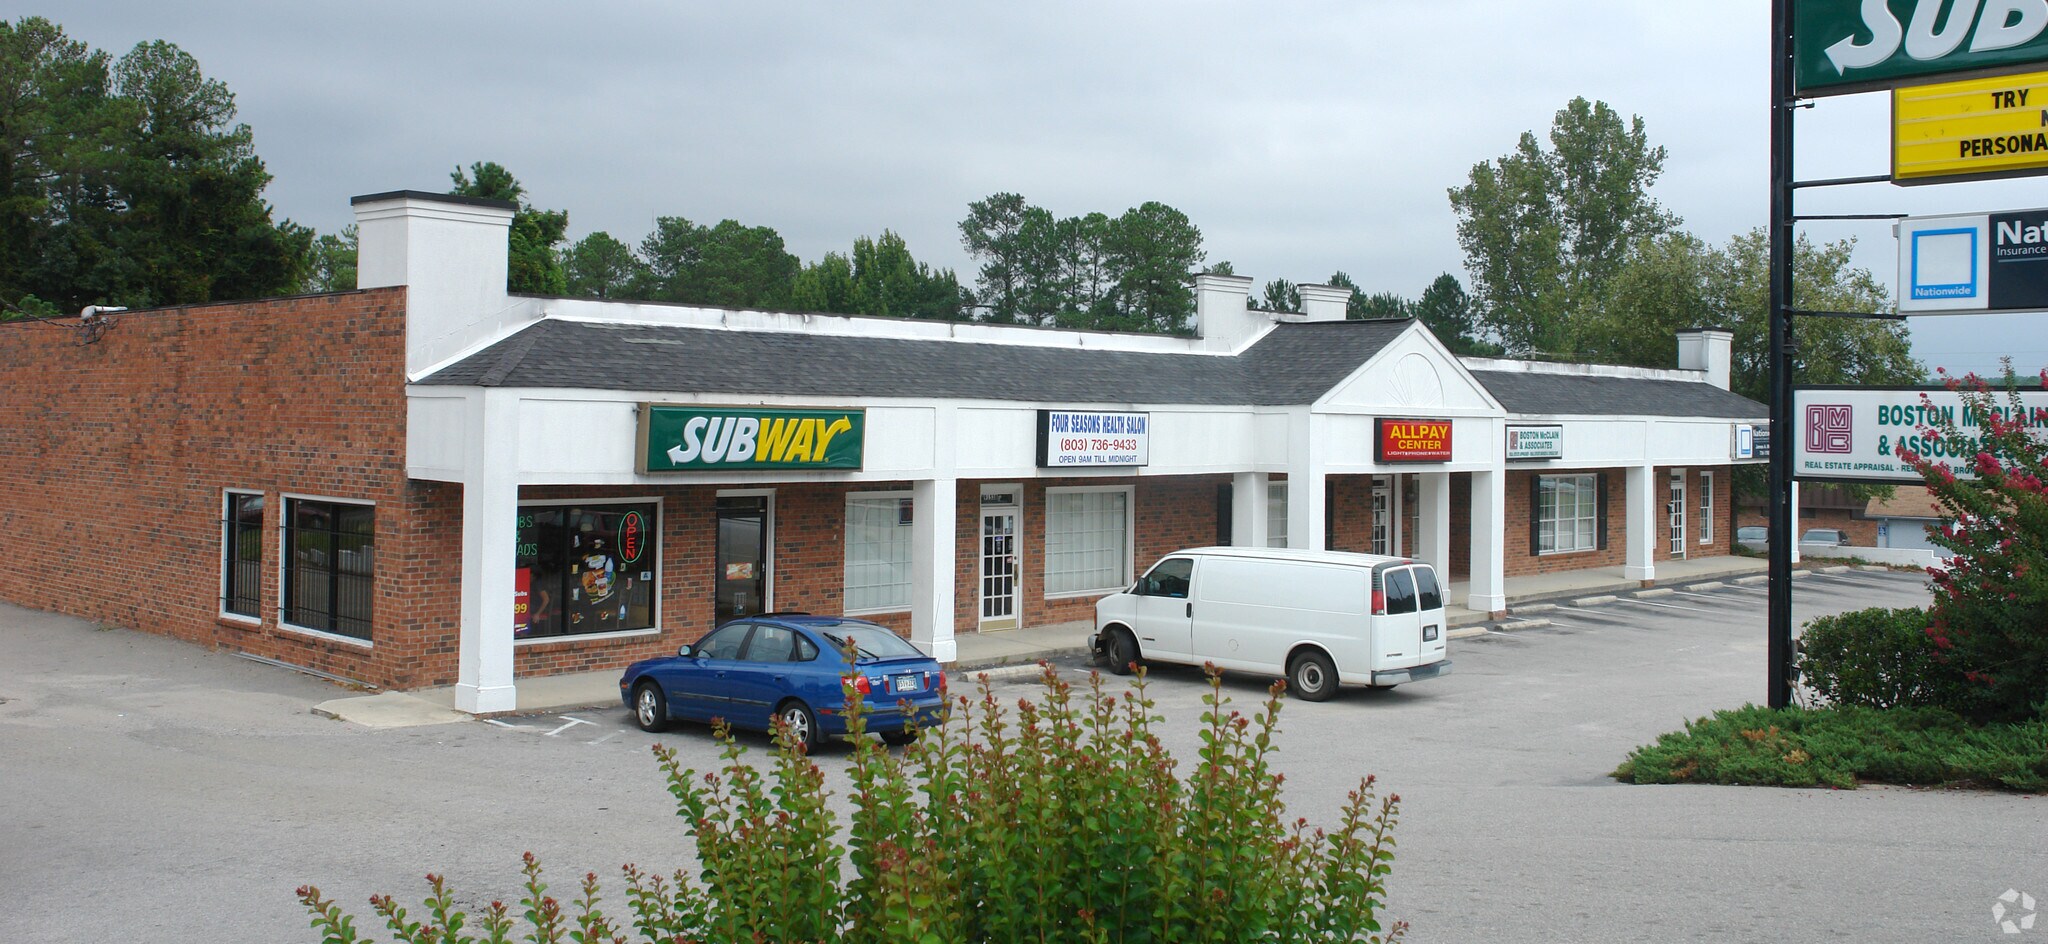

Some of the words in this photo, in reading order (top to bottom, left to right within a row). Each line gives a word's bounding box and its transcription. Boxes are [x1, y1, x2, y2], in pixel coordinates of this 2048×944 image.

[1991, 89, 2029, 110] TRY
[1960, 133, 2048, 158] PERSONA
[1997, 246, 2047, 257] Insurance
[1915, 286, 1971, 297] Nationwide
[1878, 404, 1954, 427] BOSTON
[1052, 414, 1069, 433] FOUR
[1071, 414, 1101, 434] SEASONS
[1103, 416, 1125, 434] HEALTH
[1127, 416, 1146, 435] SALON
[1390, 425, 1448, 439] ALLPAY
[1520, 431, 1539, 440] BOSTON
[667, 415, 852, 466] SUBWAY
[1060, 438, 1088, 452] (803)
[1091, 439, 1137, 451] 736-9433
[1398, 440, 1442, 450] CENTER
[1520, 441, 1524, 450] &
[1525, 441, 1553, 450] ASSOCIATES
[1878, 435, 1891, 456] &
[1059, 456, 1077, 464] OPEN
[1109, 455, 1138, 463] MIDNIGHT
[1805, 461, 1823, 469] REAL
[1825, 462, 1852, 470] ESTATE
[1854, 463, 1895, 472] APPRAISAL
[517, 515, 533, 528] BS
[625, 513, 638, 560] OPEN
